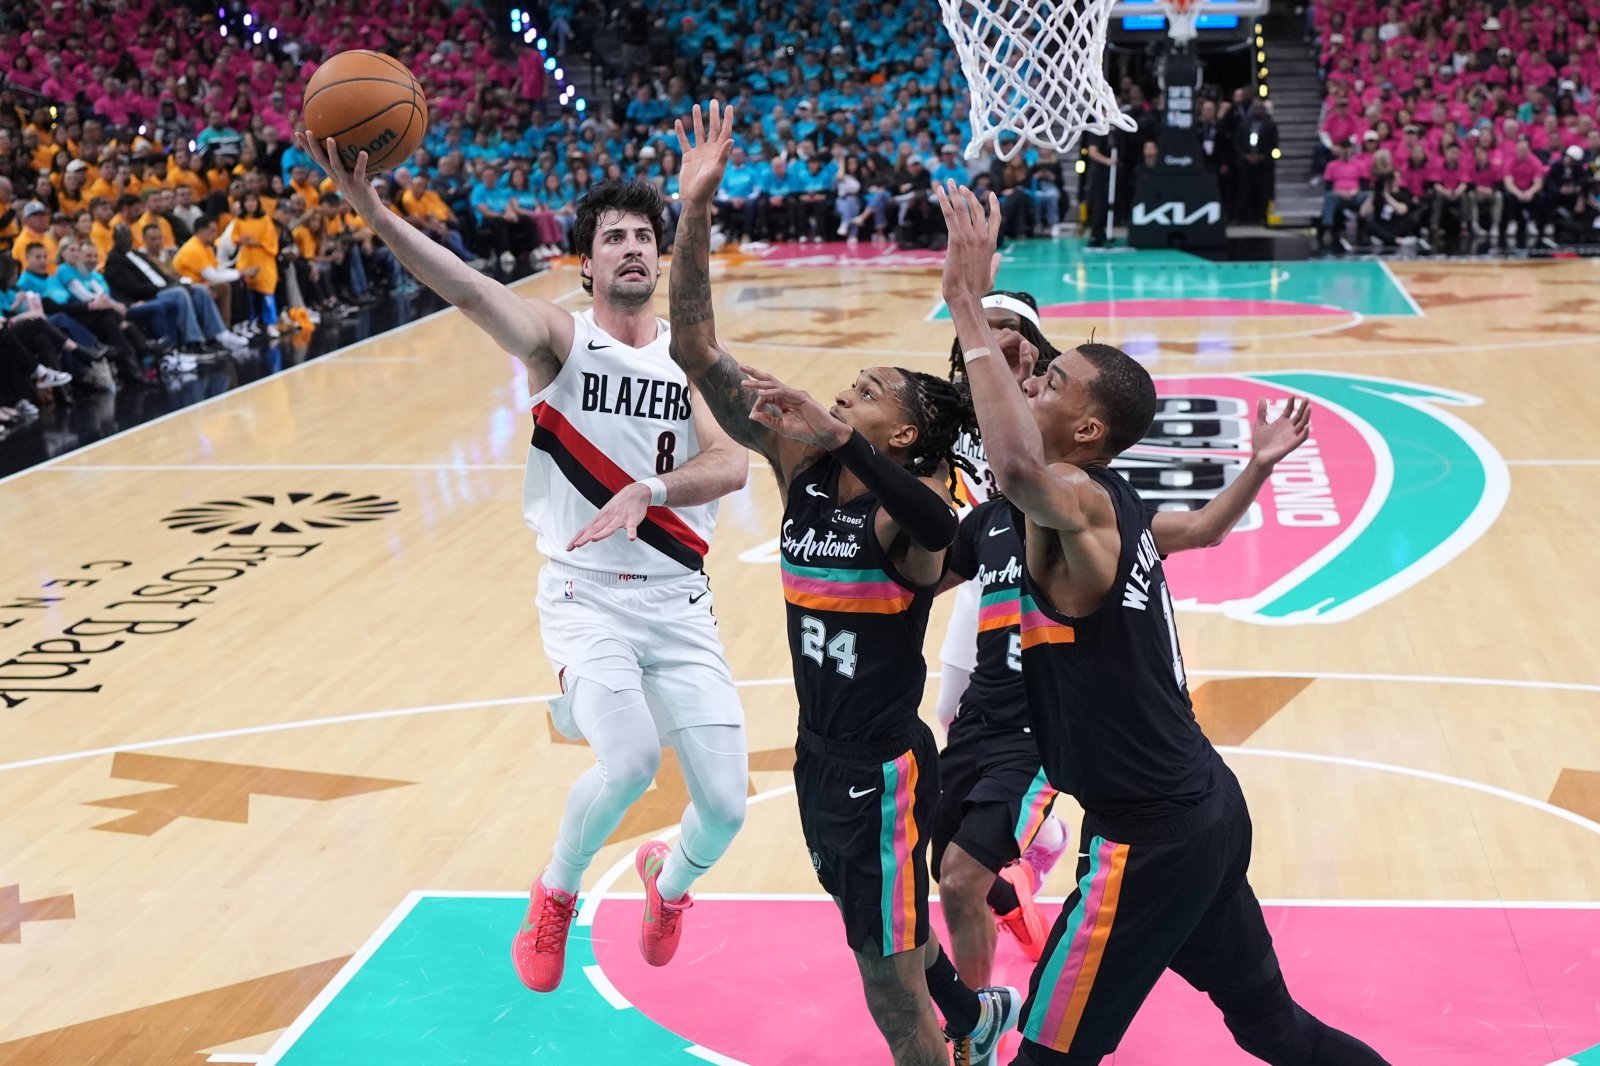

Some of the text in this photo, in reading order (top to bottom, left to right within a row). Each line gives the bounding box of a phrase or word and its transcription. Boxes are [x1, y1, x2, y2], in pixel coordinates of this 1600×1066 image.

[581, 371, 692, 421] BLAZERS
[655, 430, 677, 475] 8
[836, 513, 863, 526] LEDGER
[793, 527, 861, 562] Antonio
[105, 541, 324, 610] Frost
[800, 614, 858, 679] 24
